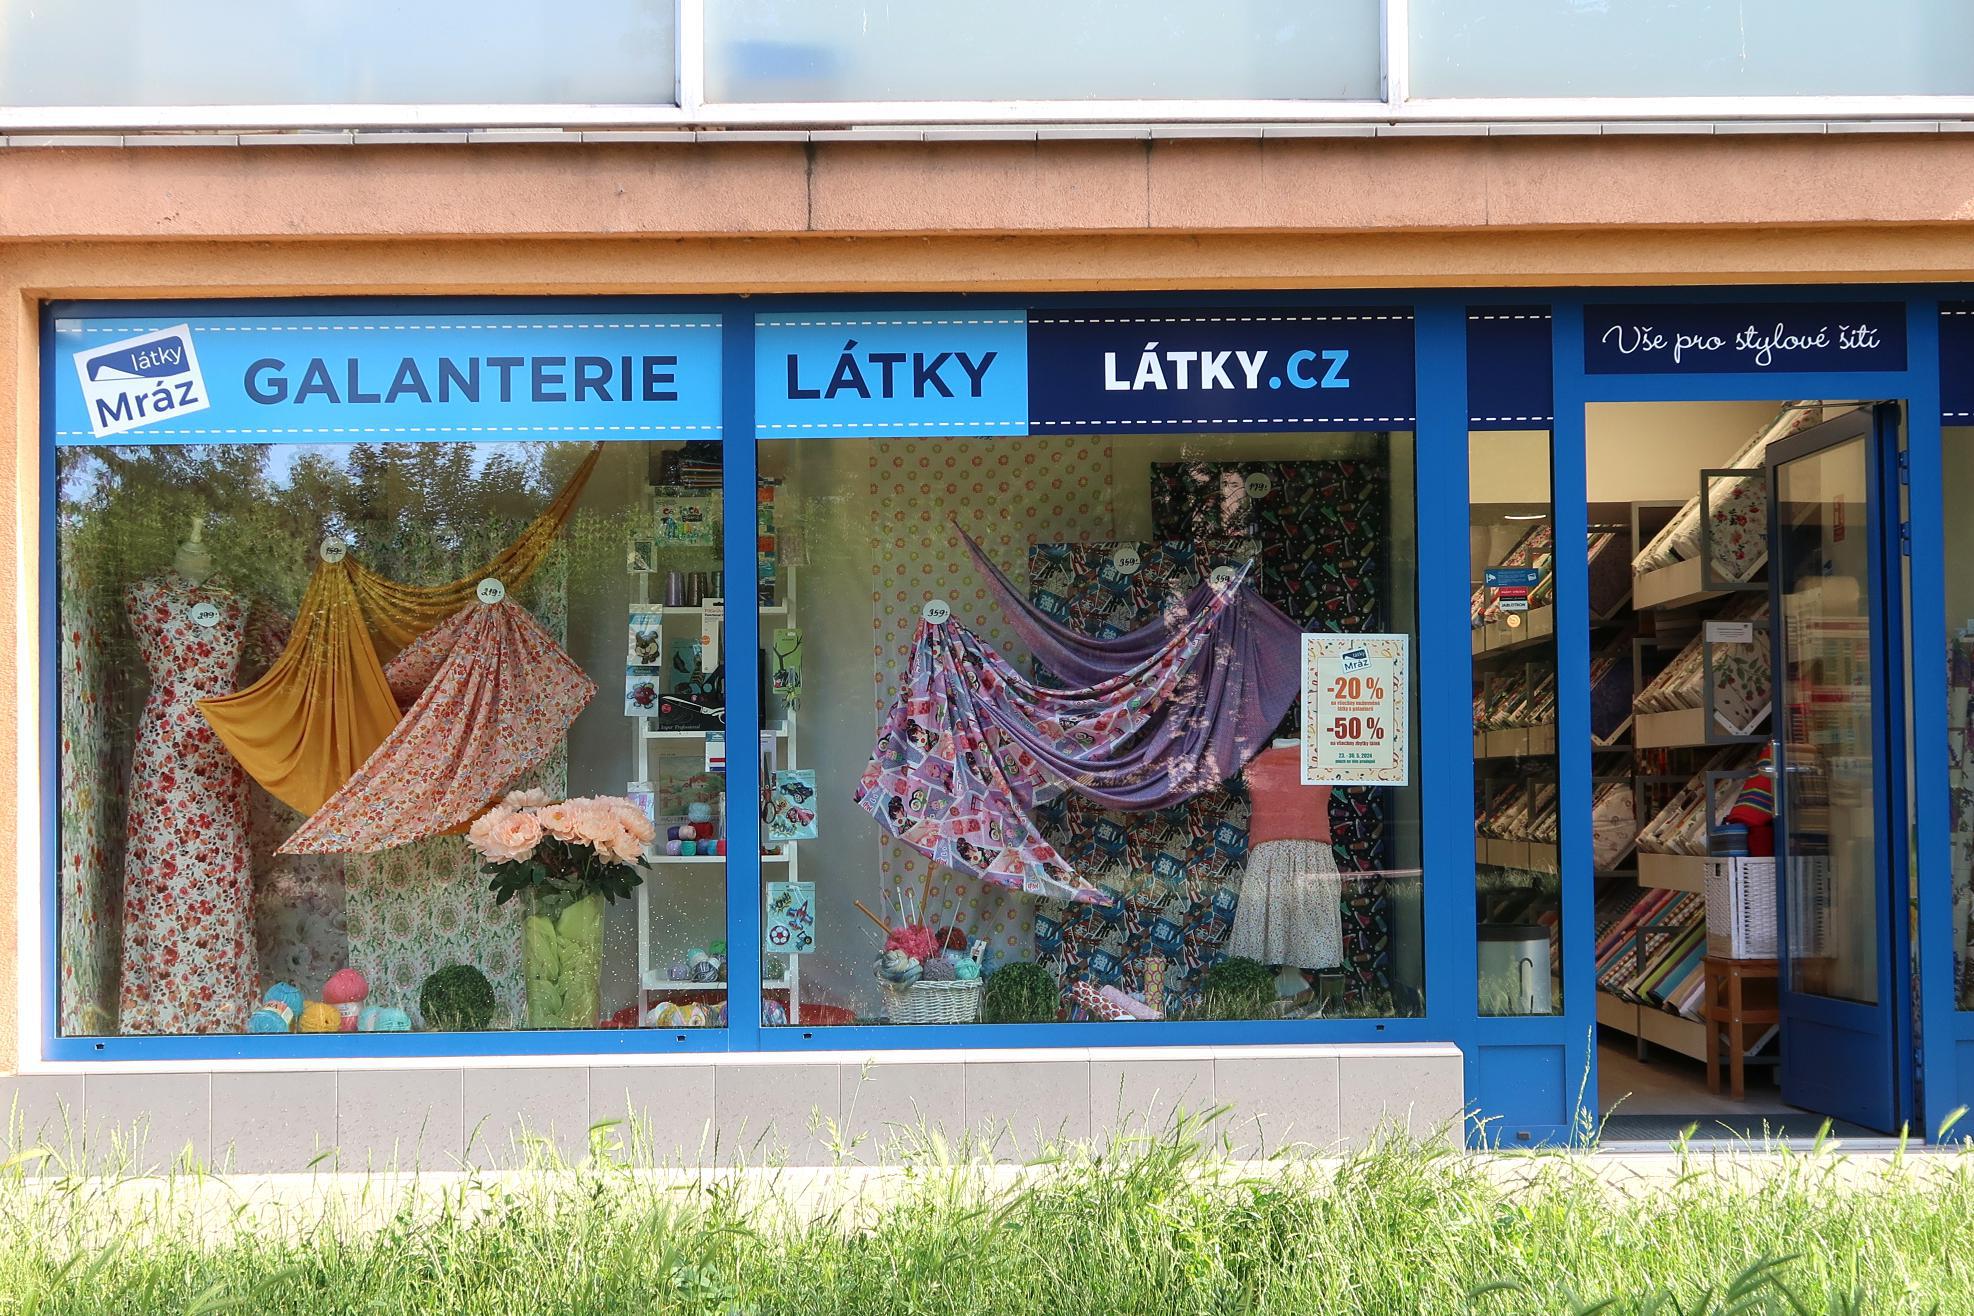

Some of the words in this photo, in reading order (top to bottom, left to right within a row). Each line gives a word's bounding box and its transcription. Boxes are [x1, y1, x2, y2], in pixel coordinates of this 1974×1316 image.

[130, 345, 182, 372] látky
[1104, 341, 1350, 391] LÁTKY.CZ
[1602, 325, 1668, 354] Vše
[1673, 333, 1726, 364] pro
[1735, 322, 1831, 366] stylové
[1838, 324, 1881, 350] šití
[243, 355, 679, 405] GALANTERIE
[786, 339, 998, 400] LÁTKY
[95, 379, 199, 429] Mráz
[1344, 659, 1369, 671] Mráz
[1327, 676, 1361, 700] -20
[1366, 677, 1384, 700] %
[1326, 716, 1361, 740] -50
[1366, 717, 1385, 740] %
